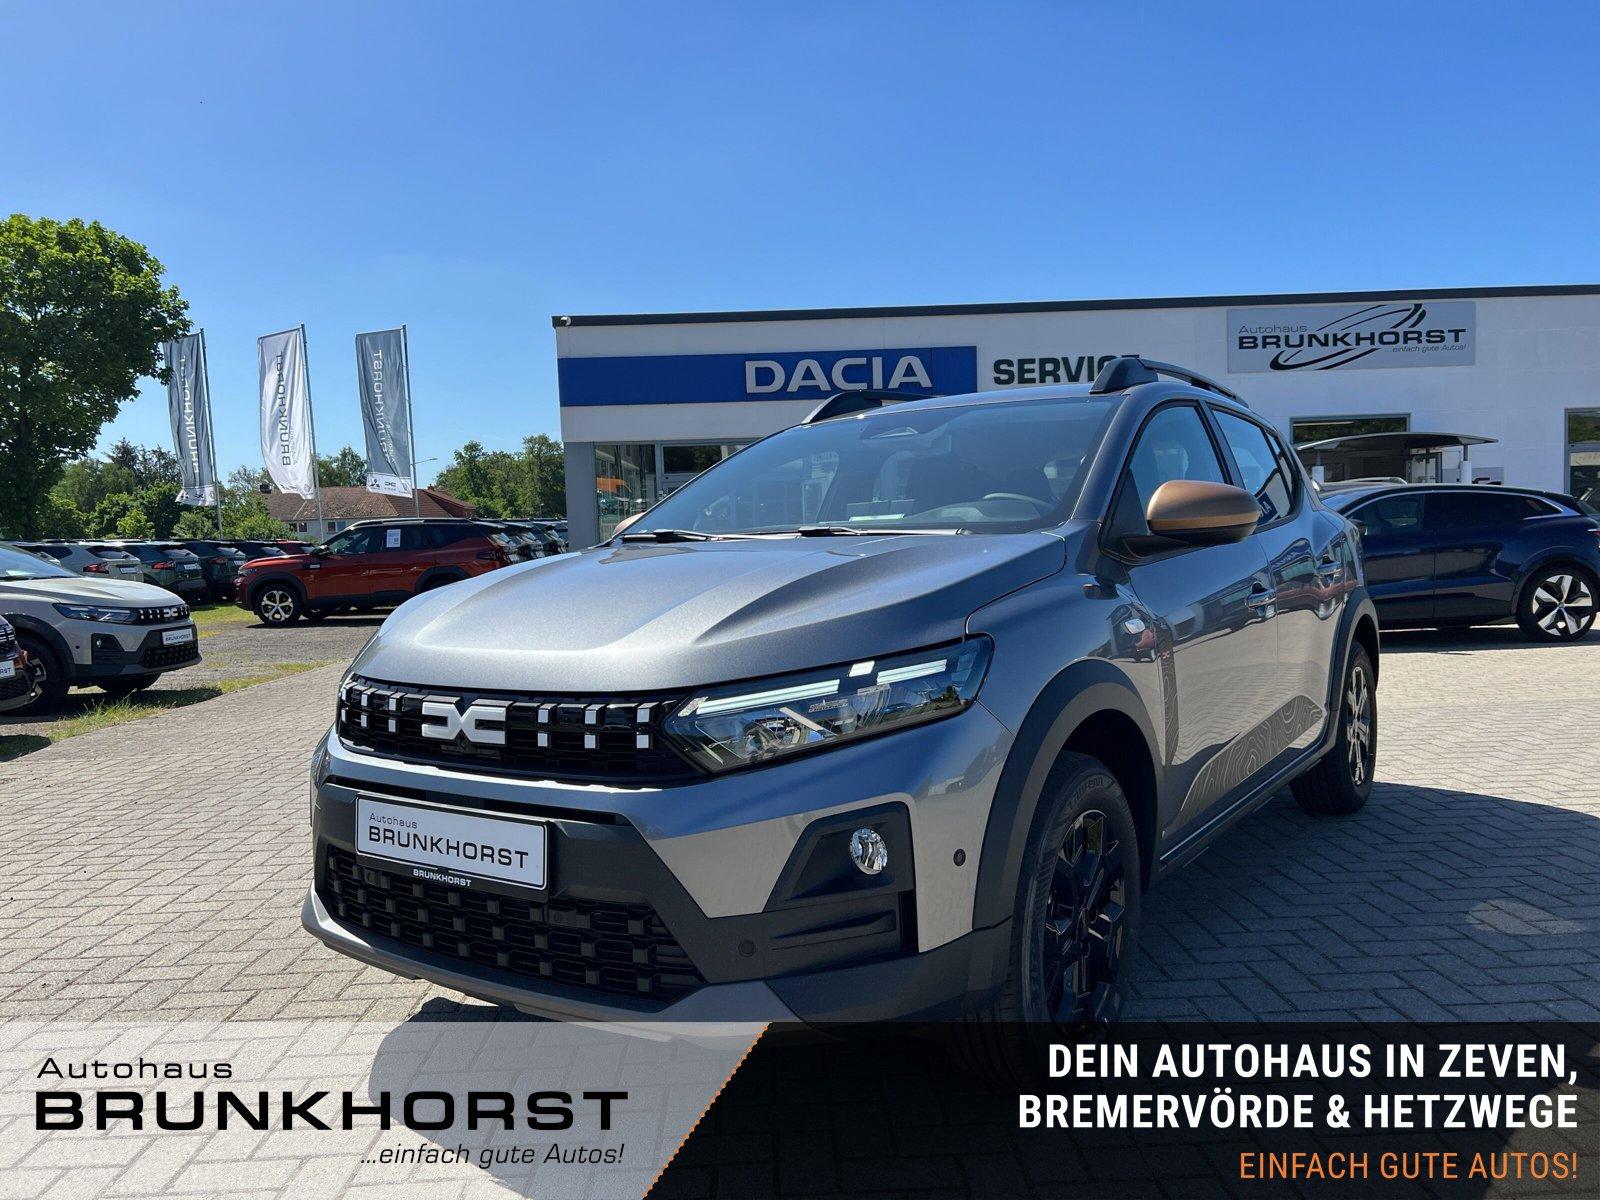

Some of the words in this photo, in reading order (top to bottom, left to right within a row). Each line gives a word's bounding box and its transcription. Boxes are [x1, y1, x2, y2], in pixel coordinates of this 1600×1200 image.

[1238, 324, 1308, 335] Autohaus
[1238, 328, 1467, 350] BRUNKHORST
[1422, 345, 1440, 353] gute
[1441, 343, 1467, 352] Autos!
[745, 355, 932, 394] DACIA
[993, 354, 1140, 386] SERVI
[369, 812, 417, 829] Autohaus
[368, 825, 529, 870] BRUNKHORST
[412, 868, 472, 887] BRUNKHORST
